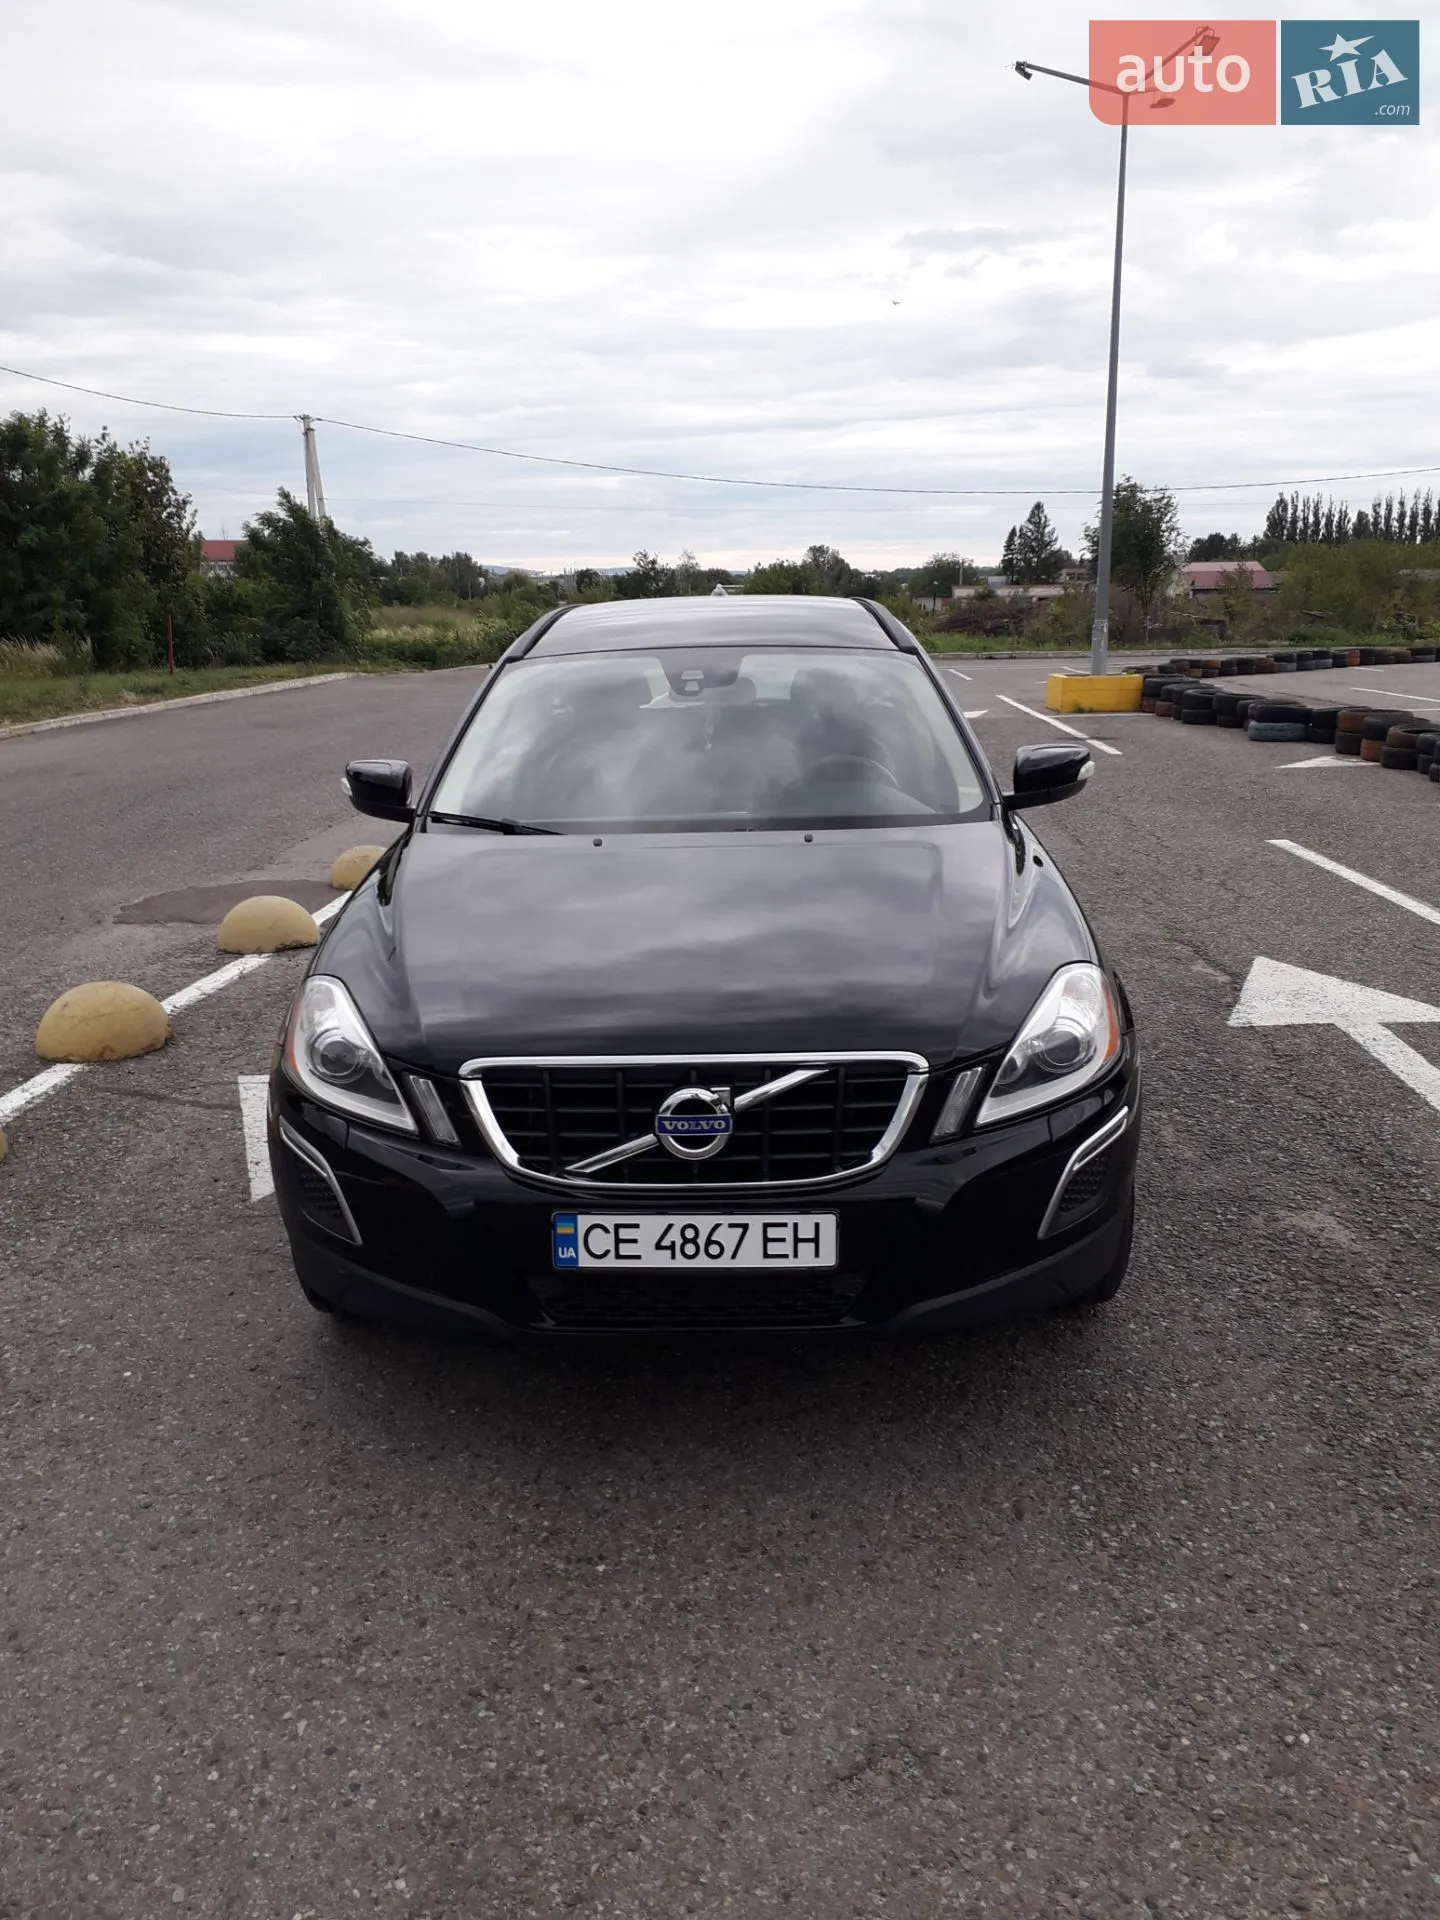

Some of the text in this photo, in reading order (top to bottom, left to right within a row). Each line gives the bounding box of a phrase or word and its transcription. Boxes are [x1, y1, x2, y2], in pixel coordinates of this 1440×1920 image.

[661, 1120, 726, 1131] VOLVO
[583, 1221, 821, 1260] CE 4867 EH
[558, 1247, 577, 1258] UA
